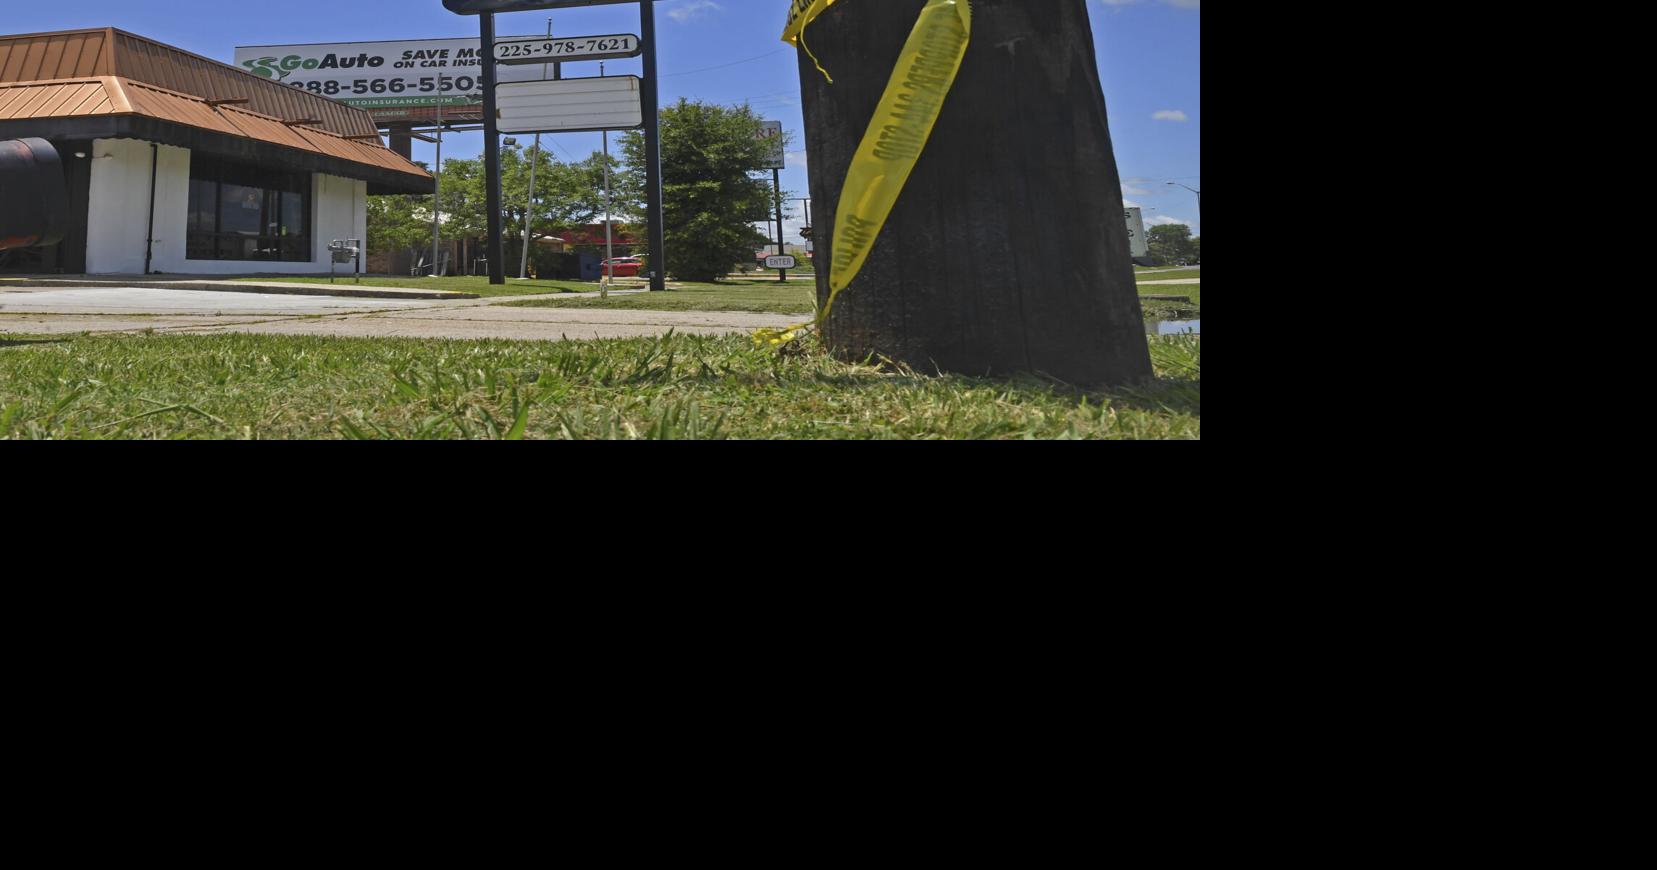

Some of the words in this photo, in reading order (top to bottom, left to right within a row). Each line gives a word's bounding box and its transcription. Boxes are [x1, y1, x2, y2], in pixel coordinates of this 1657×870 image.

[500, 38, 629, 57] 225-978-7621
[402, 49, 449, 60] SAVE
[280, 53, 384, 70] GoAuto
[393, 61, 415, 69] ON
[420, 60, 447, 68] CAR
[769, 257, 791, 266] ENTER
